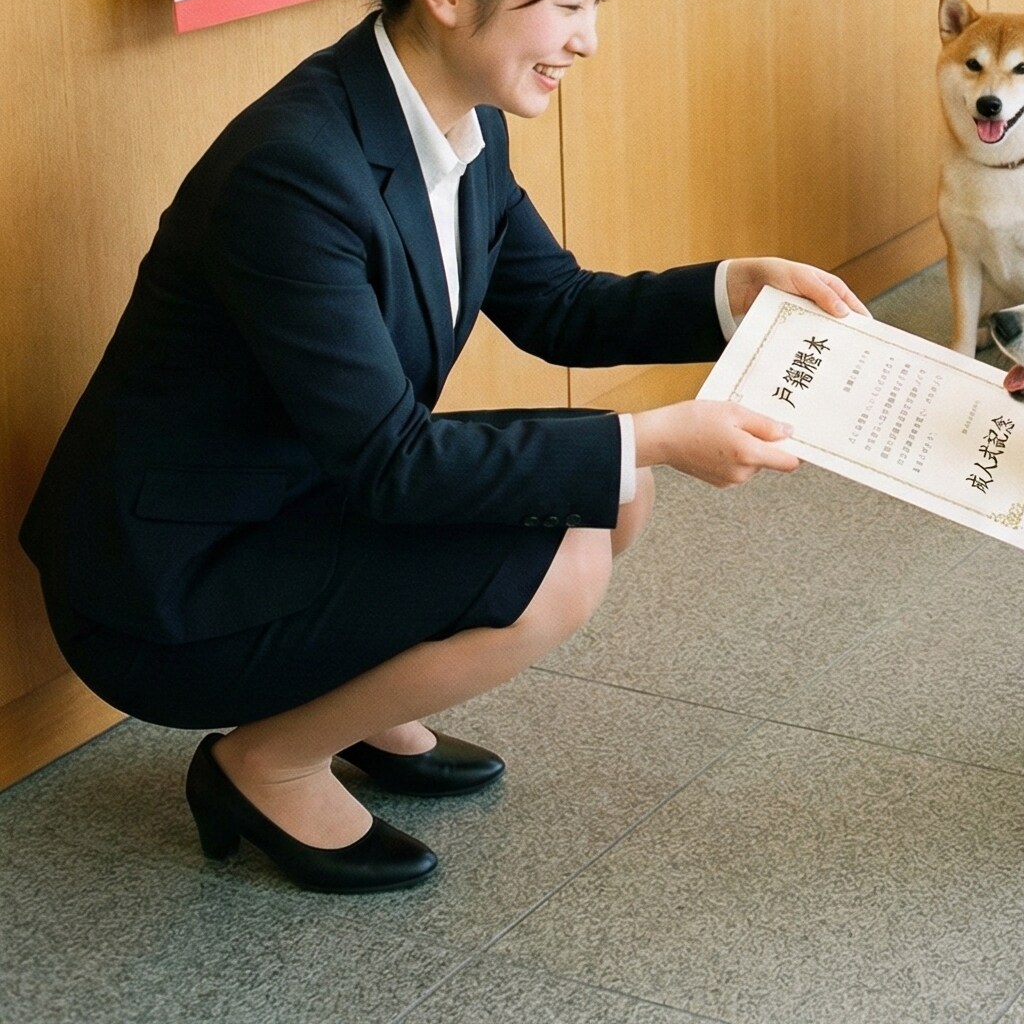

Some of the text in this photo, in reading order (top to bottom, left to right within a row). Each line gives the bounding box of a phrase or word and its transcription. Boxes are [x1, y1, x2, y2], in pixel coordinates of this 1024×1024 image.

[965, 415, 1016, 494] 成人式記念
